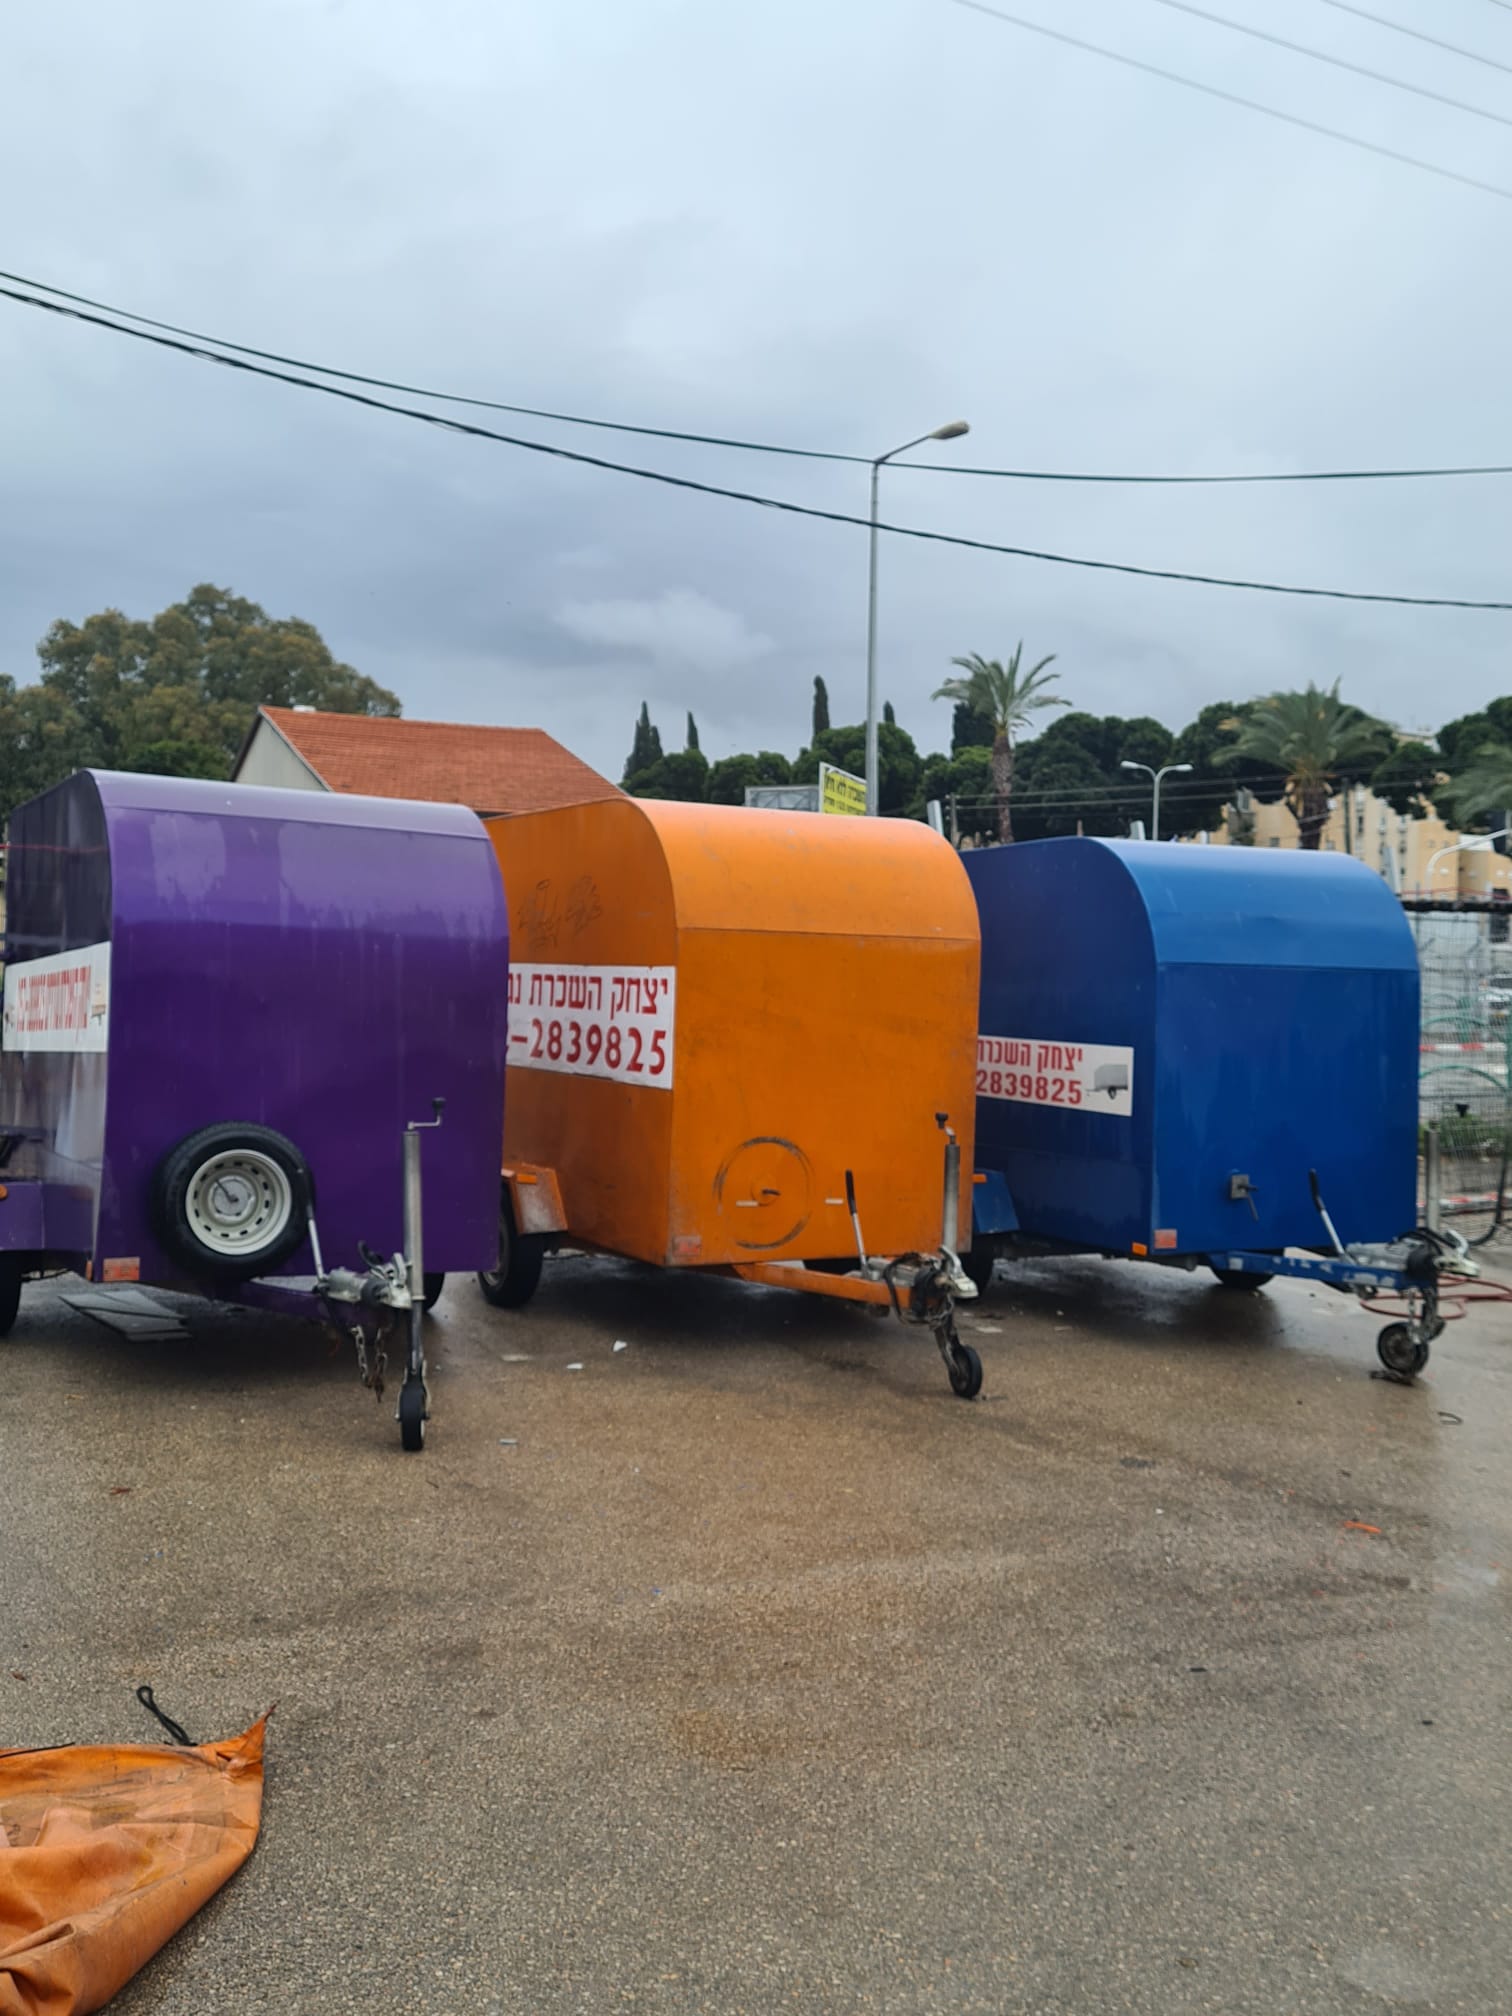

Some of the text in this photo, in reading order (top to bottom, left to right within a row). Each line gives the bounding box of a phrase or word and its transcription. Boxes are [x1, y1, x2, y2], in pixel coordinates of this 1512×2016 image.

[528, 973, 602, 1011] השכרת
[610, 976, 669, 1020] יצחק
[506, 1017, 667, 1076] -2839825
[1037, 1044, 1084, 1074] יצחק
[976, 1069, 1083, 1105] 2839825
